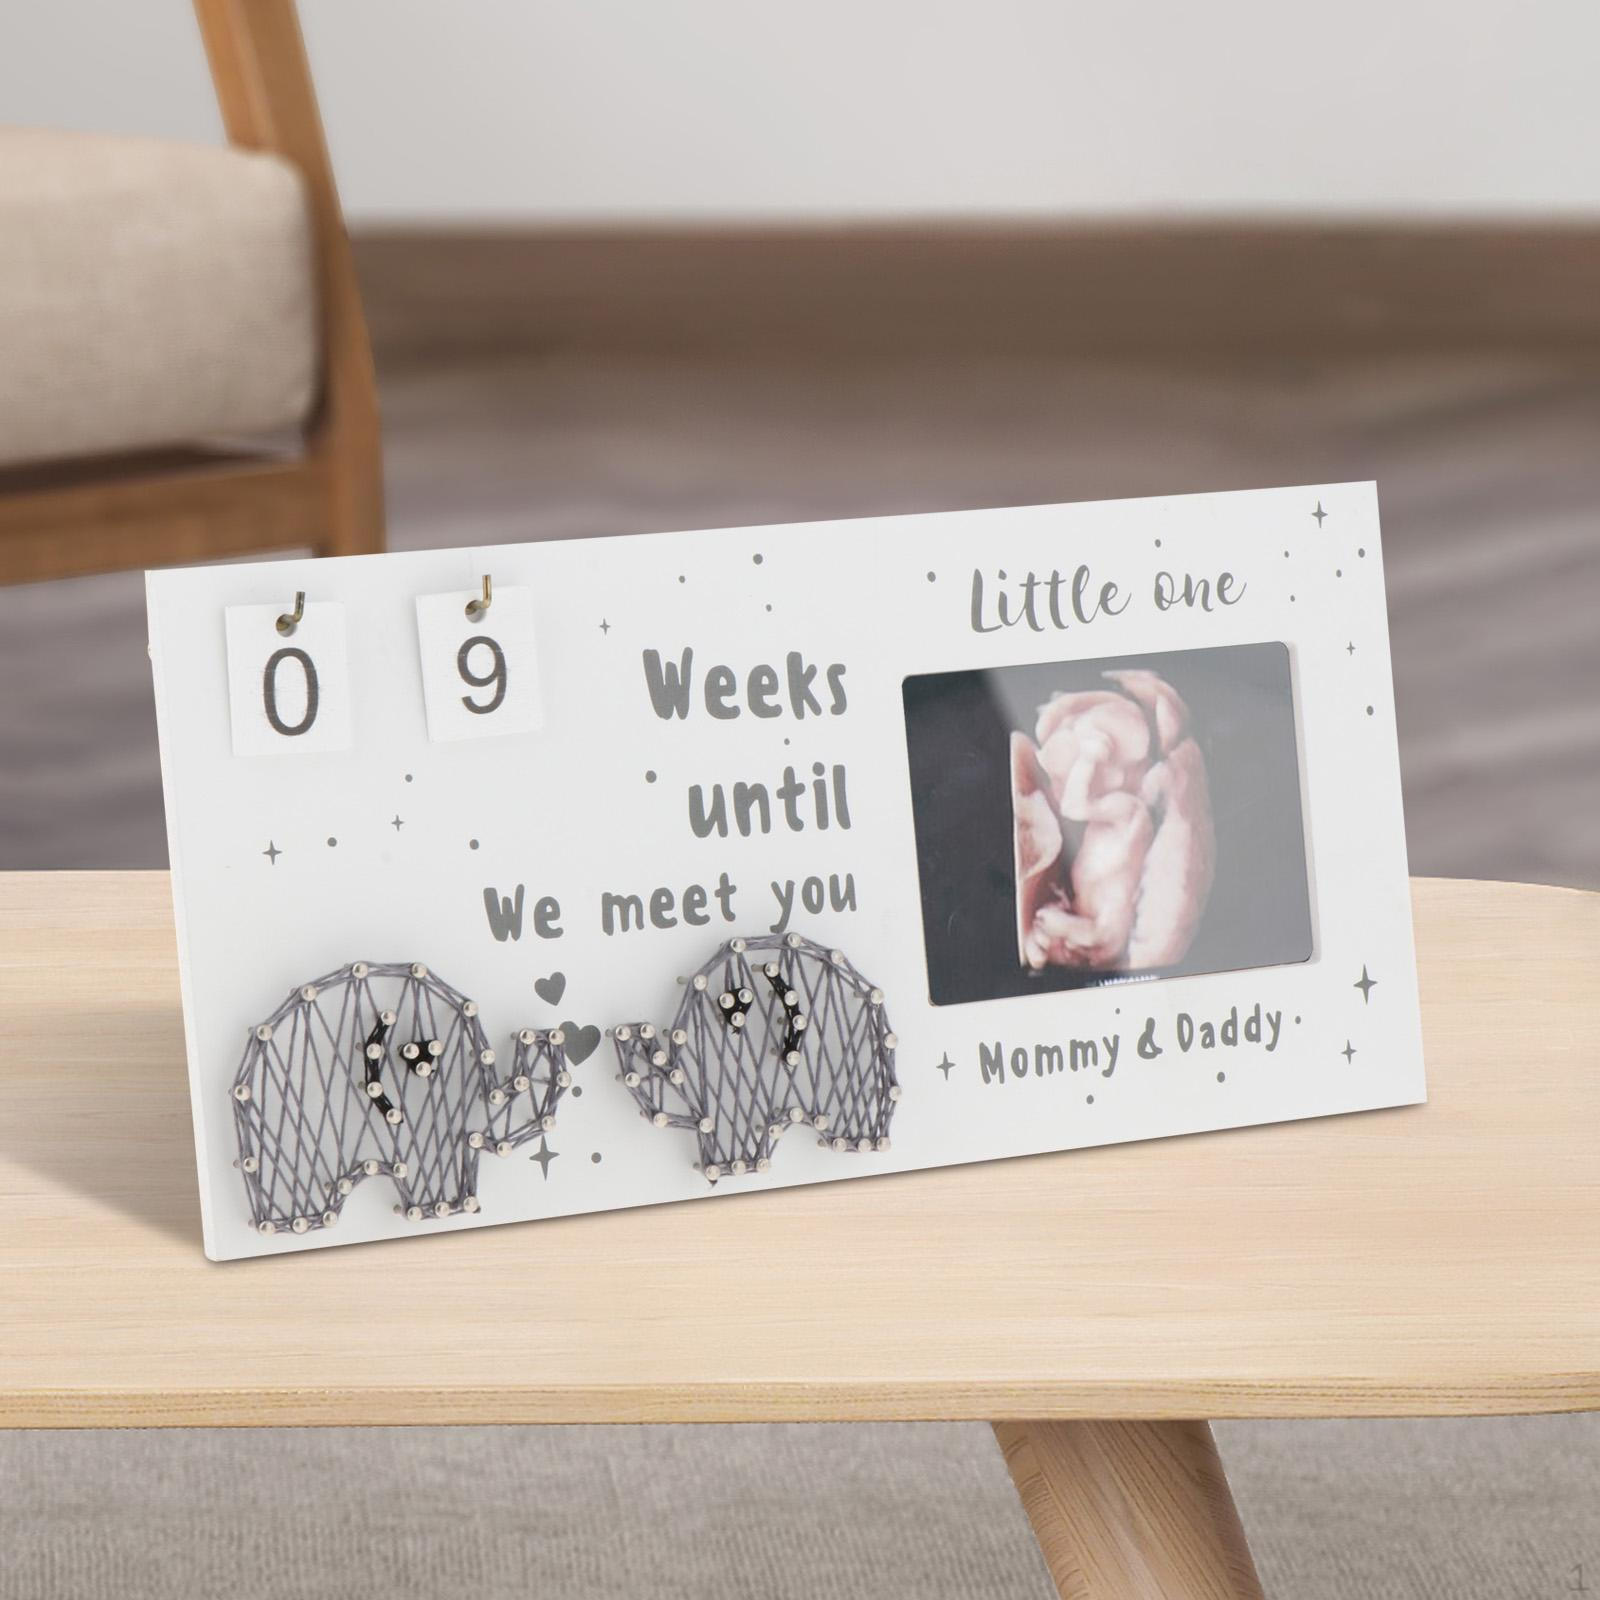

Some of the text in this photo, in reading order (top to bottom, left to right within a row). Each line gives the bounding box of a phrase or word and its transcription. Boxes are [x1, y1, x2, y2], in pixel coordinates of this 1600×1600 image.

[971, 564, 1247, 633] Little one
[642, 646, 848, 720] Weeks
[688, 761, 851, 839] until
[483, 872, 858, 942] We meet you
[978, 1003, 1283, 1085] Mommy & Daddy
